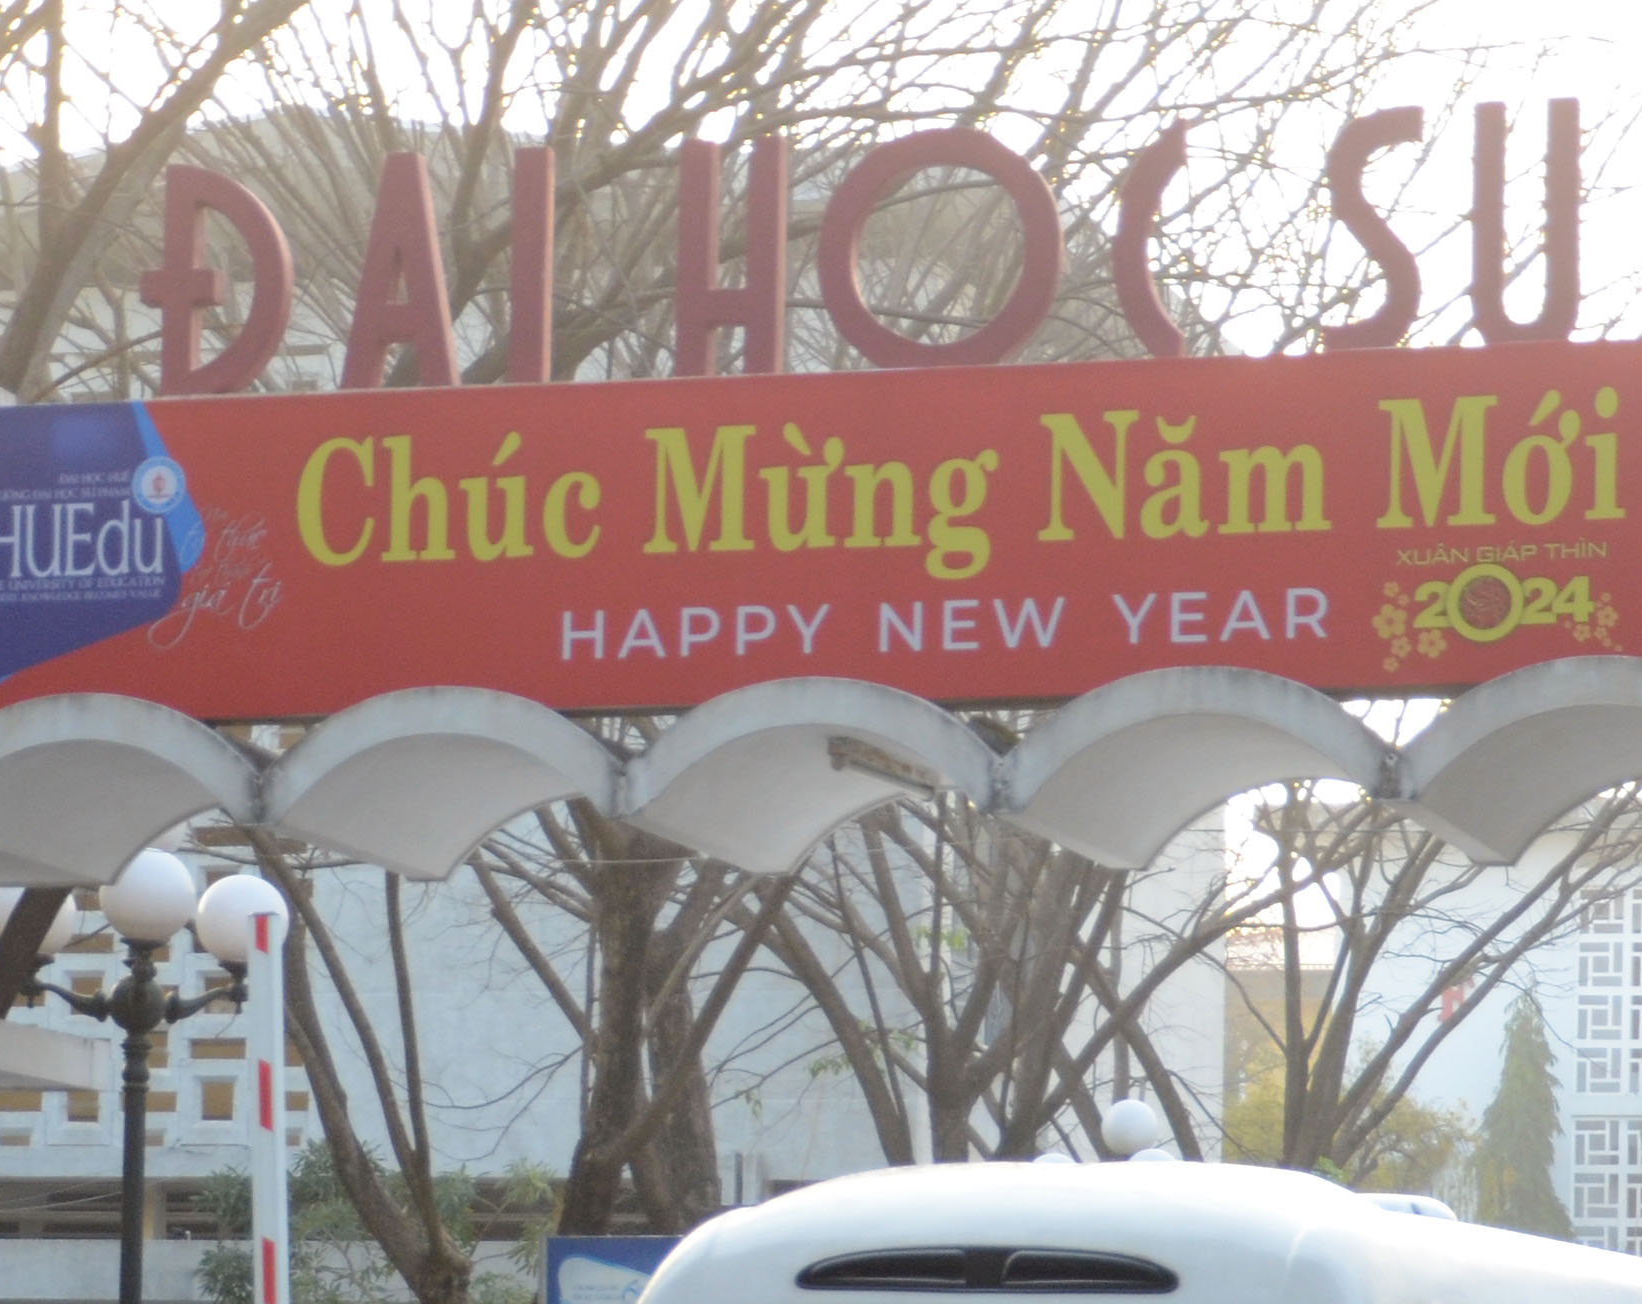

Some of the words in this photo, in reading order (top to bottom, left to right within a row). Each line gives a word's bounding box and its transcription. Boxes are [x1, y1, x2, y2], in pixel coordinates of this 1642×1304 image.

[296, 431, 602, 567] Chúc
[643, 422, 999, 579] Mừng
[1038, 410, 1332, 541] Năm
[1376, 386, 1626, 530] Mới
[1397, 543, 1469, 565] XUÂN
[1476, 540, 1538, 562] GIÁP
[1543, 537, 1607, 559] THÌN
[561, 603, 830, 660] HAPPY
[878, 597, 1066, 652] NEW
[1112, 587, 1330, 644] YEAR
[1413, 563, 1596, 642] 2024
